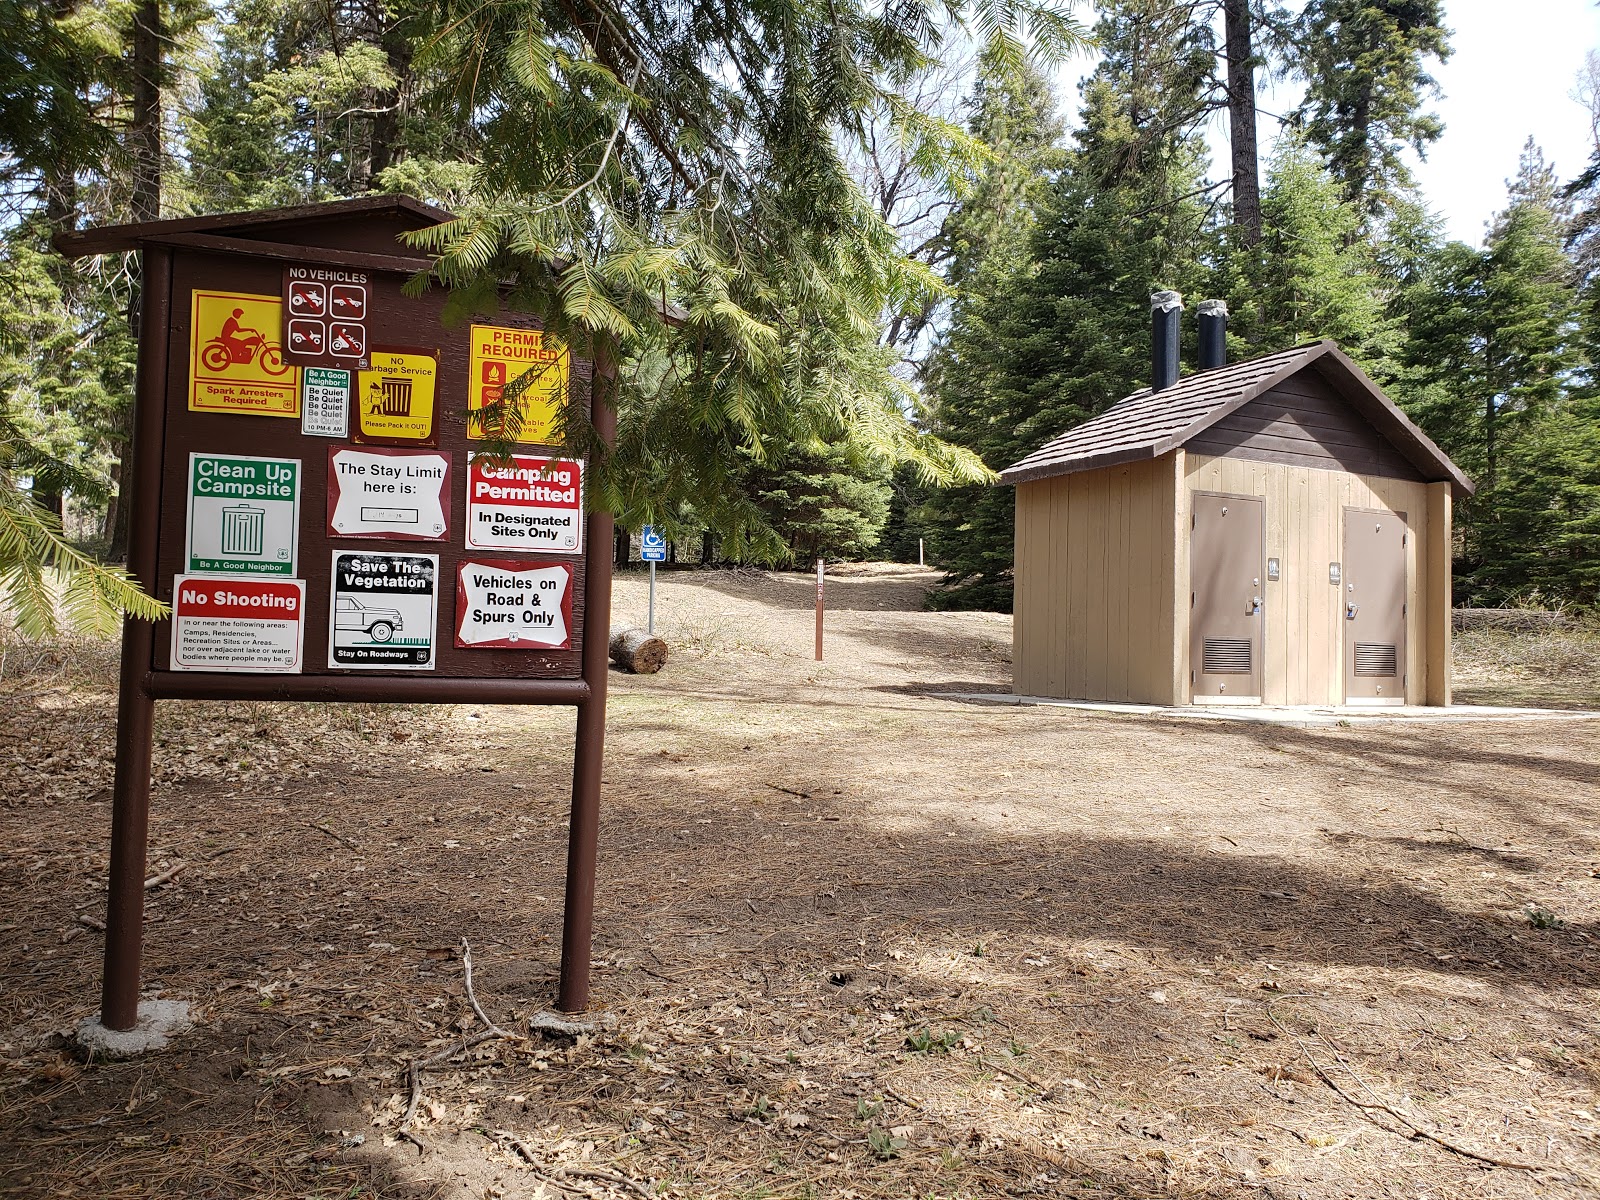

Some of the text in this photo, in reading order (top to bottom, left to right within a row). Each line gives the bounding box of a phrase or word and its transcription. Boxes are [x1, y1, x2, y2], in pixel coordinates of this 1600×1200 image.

[290, 268, 367, 284] NO VEHICLES
[482, 344, 558, 361] REQUIRED
[328, 371, 347, 380] Good
[371, 366, 398, 375] arbage
[400, 367, 432, 376] Service
[308, 378, 341, 386] Neighbor
[510, 372, 553, 382] Cares
[207, 386, 284, 398] Spark Arresters
[322, 388, 344, 397] Quiet
[223, 396, 267, 406] Required
[321, 396, 343, 404] Quiet
[515, 394, 548, 403] arcoal
[321, 403, 343, 411] Quiet
[321, 410, 342, 418] Quiet
[511, 417, 545, 426] table
[198, 460, 292, 483] Clean Up
[339, 463, 442, 479] The Stay Limit
[481, 462, 571, 486] Camping
[197, 477, 292, 497] Campsite
[364, 481, 416, 494] here is:
[475, 482, 576, 503] Permitted
[479, 512, 571, 527] In Designated
[491, 525, 558, 540] Sites Only
[223, 562, 245, 570] Good
[248, 563, 282, 571] Neighbor
[351, 559, 421, 574] Save The
[344, 574, 426, 589] Vegetation
[473, 575, 557, 590] Vehicles on
[182, 590, 297, 611] No Shooting
[487, 592, 541, 607] Road &
[473, 609, 555, 626] Spurs Only
[233, 621, 265, 630] following
[184, 629, 257, 638] Camps, Residencies,
[214, 646, 244, 655] adjacent
[338, 650, 355, 658] Stay
[370, 650, 409, 658] Roadways
[231, 655, 255, 663] people
